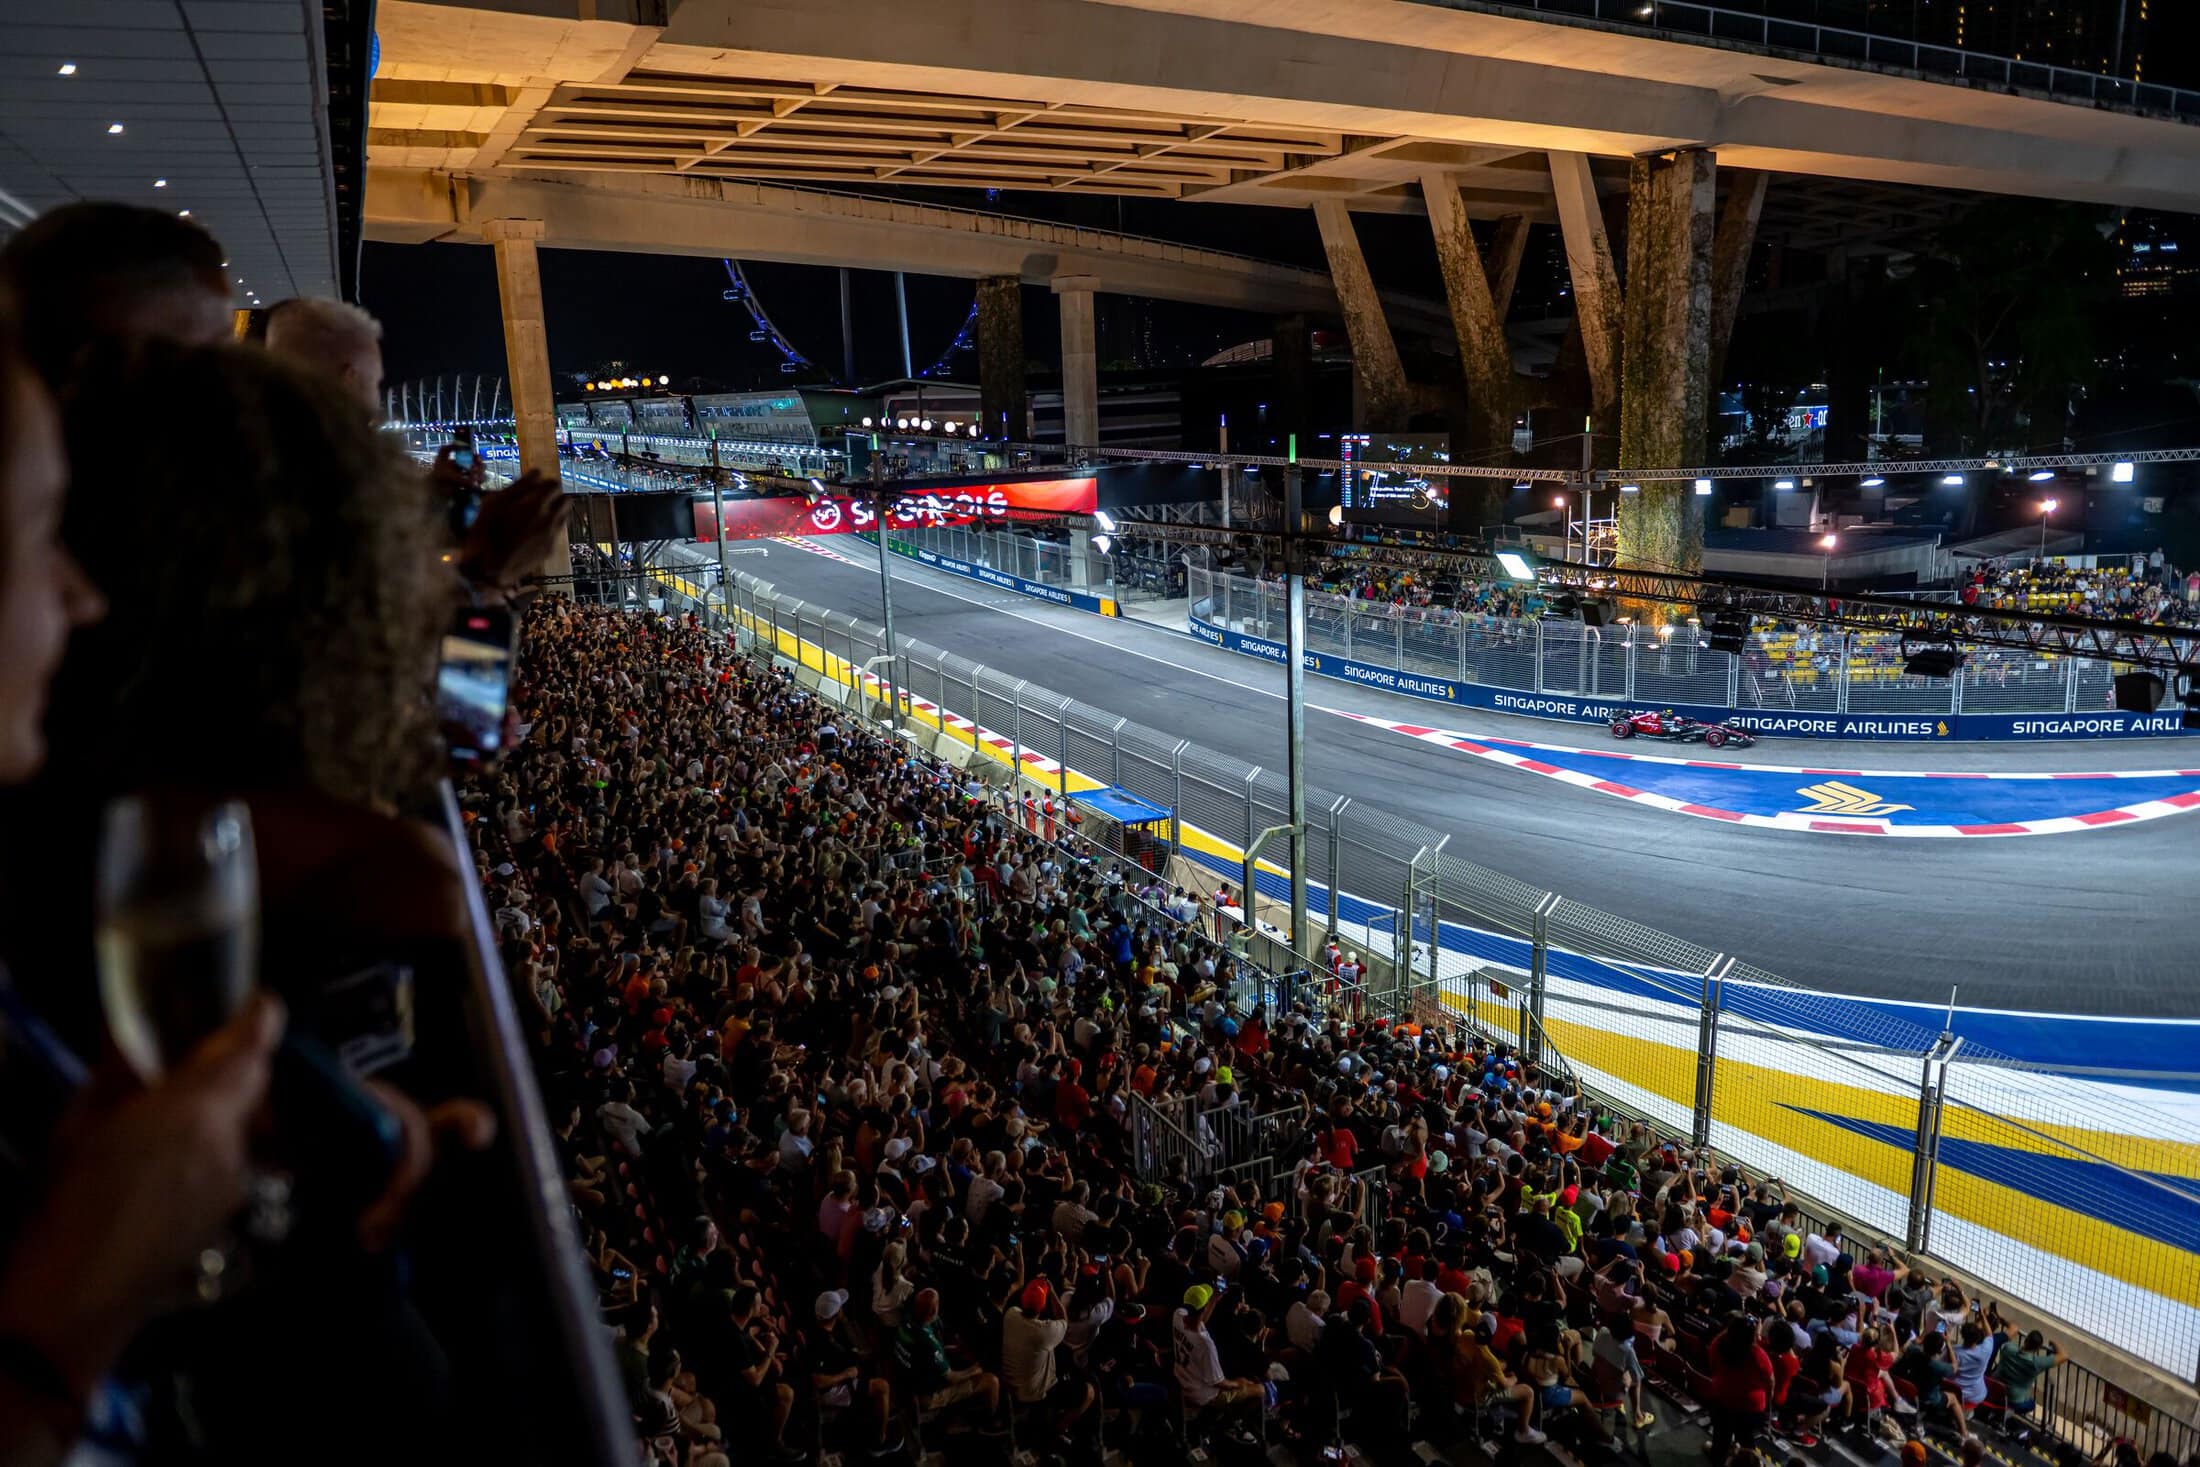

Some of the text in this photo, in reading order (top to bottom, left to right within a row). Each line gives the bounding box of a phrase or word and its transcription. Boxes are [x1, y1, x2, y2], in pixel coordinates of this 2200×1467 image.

[1241, 639, 1280, 658] SINGAPORE
[1344, 665, 1446, 696] SINGAPORE AIRLINES
[1494, 694, 1577, 715] SINGAPORE
[1728, 716, 1933, 735] SINGAPORE AIRLINES
[2012, 719, 2125, 734] SINGAPORE
[1434, 1221, 1449, 1247] 2
